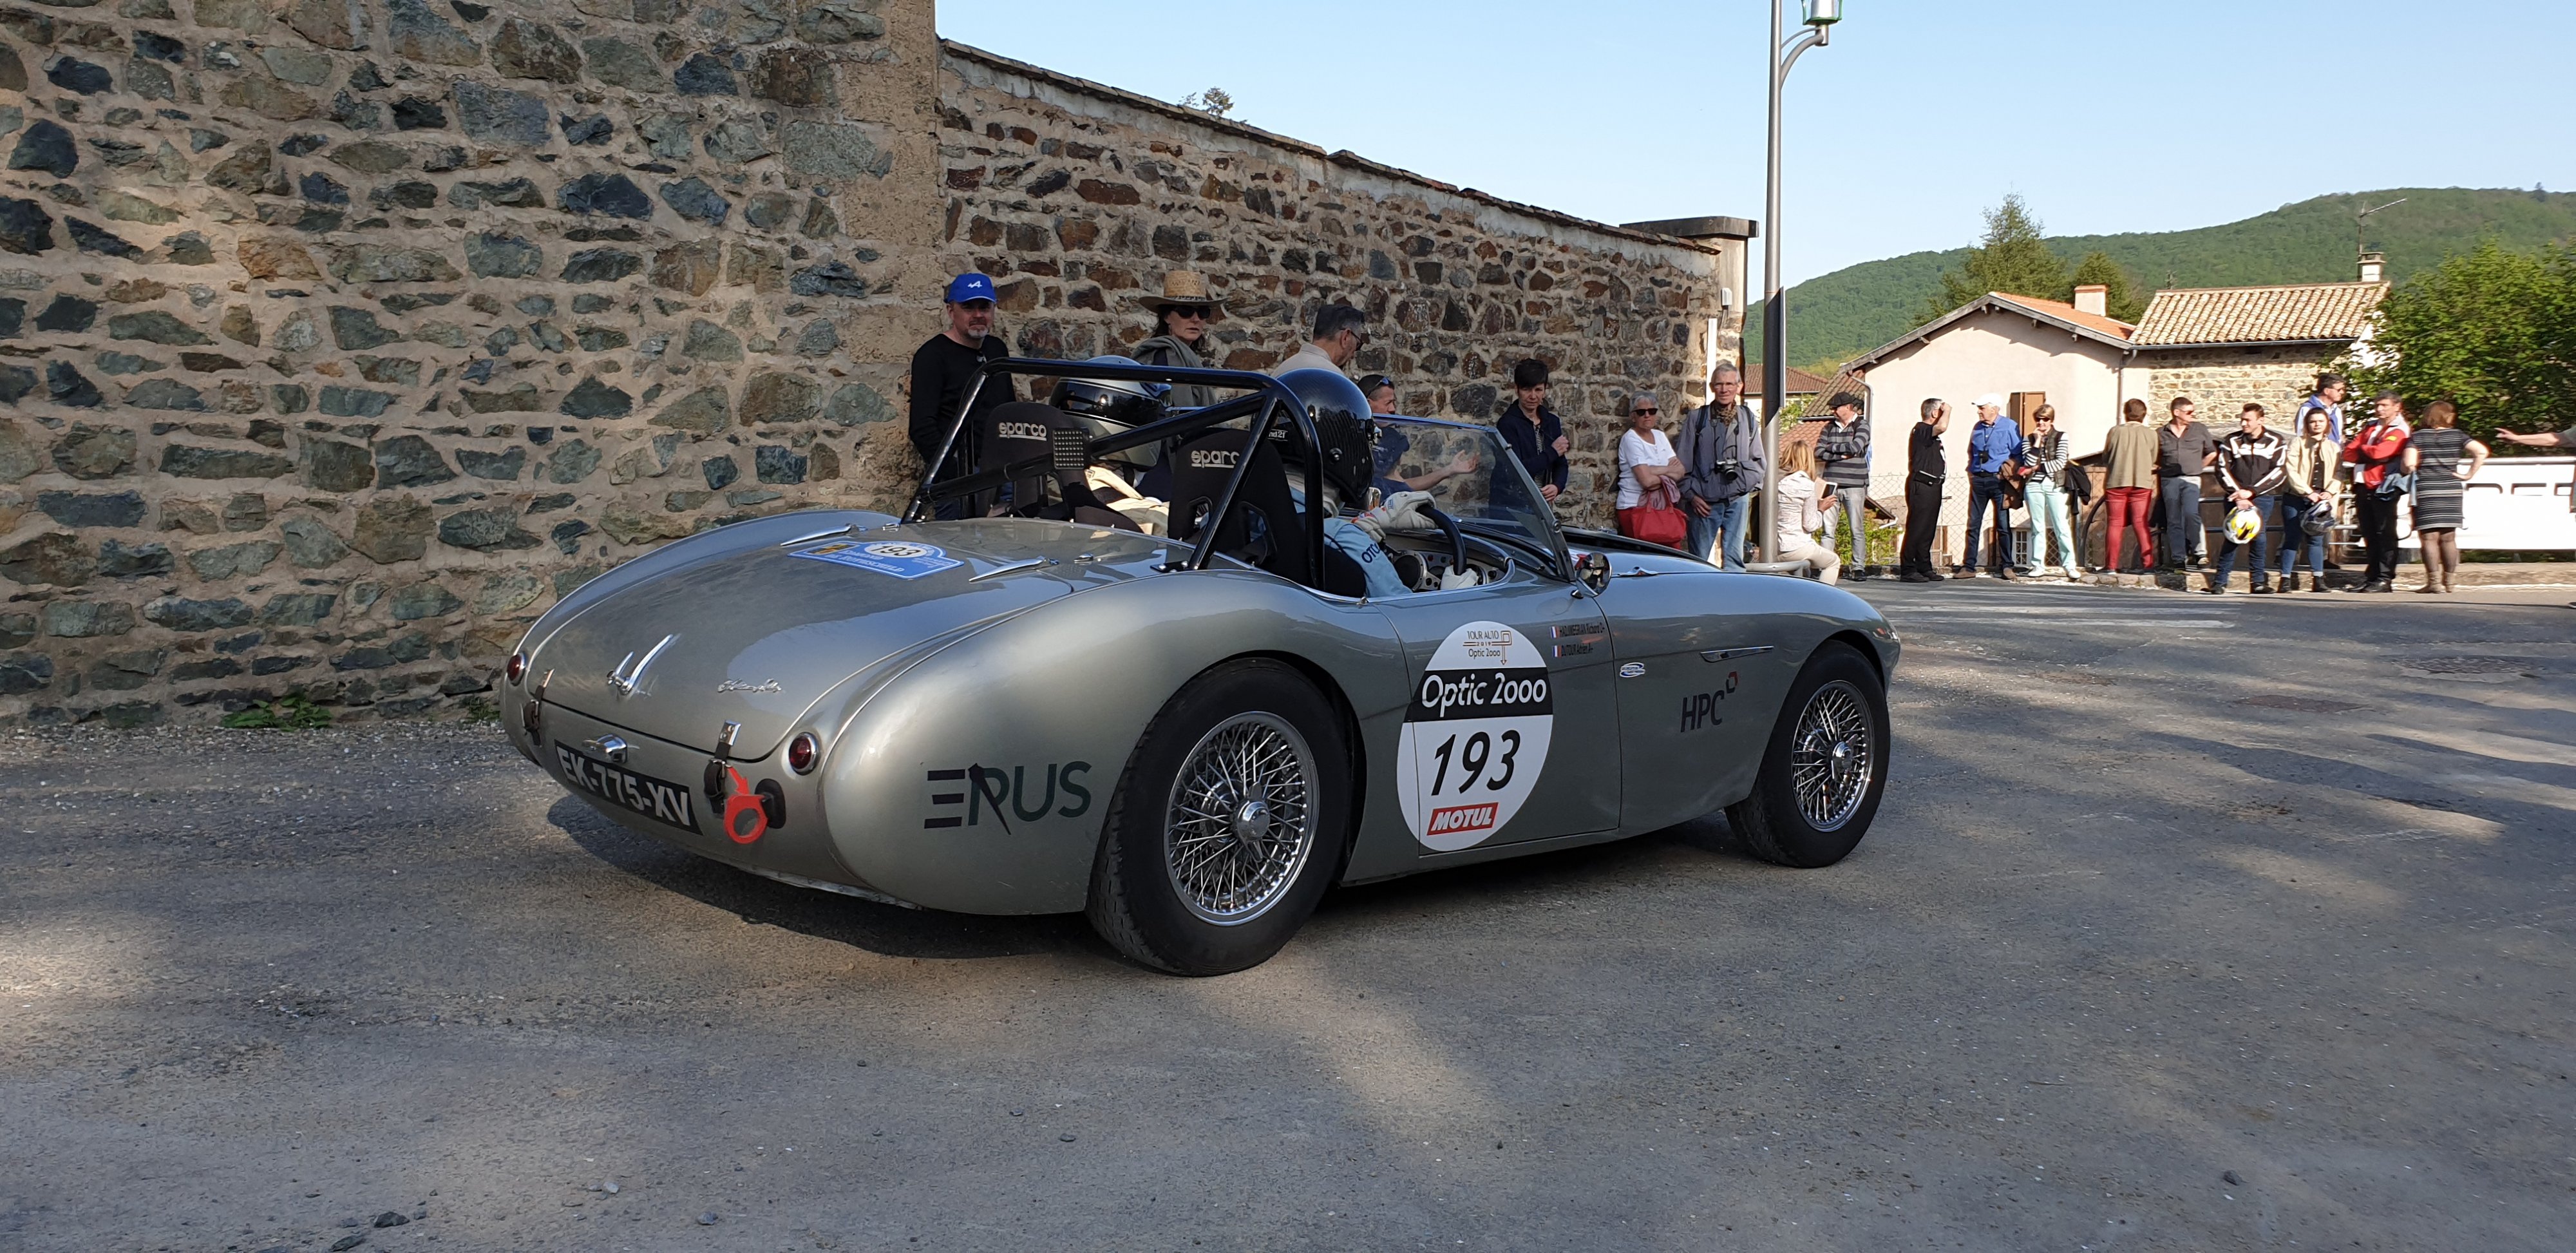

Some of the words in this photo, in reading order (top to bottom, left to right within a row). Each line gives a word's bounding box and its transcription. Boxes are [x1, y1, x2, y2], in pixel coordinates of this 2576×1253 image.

[998, 422, 1047, 438] sparco
[1268, 430, 1287, 439] nd21
[1191, 450, 1240, 466] sparc
[871, 545, 920, 557] 193
[1467, 631, 1483, 640] TOUR
[1484, 630, 1499, 640] AUTO
[1468, 648, 1485, 660] Optic
[1486, 648, 1501, 656] 2000
[1421, 673, 1488, 718] Optic
[1490, 672, 1547, 704] 2000
[1680, 690, 1725, 732] HPC
[1431, 729, 1520, 796] 193
[556, 745, 691, 827] EK-775-XV
[923, 761, 1092, 836] ERUS
[1430, 807, 1493, 832] MOTUL
